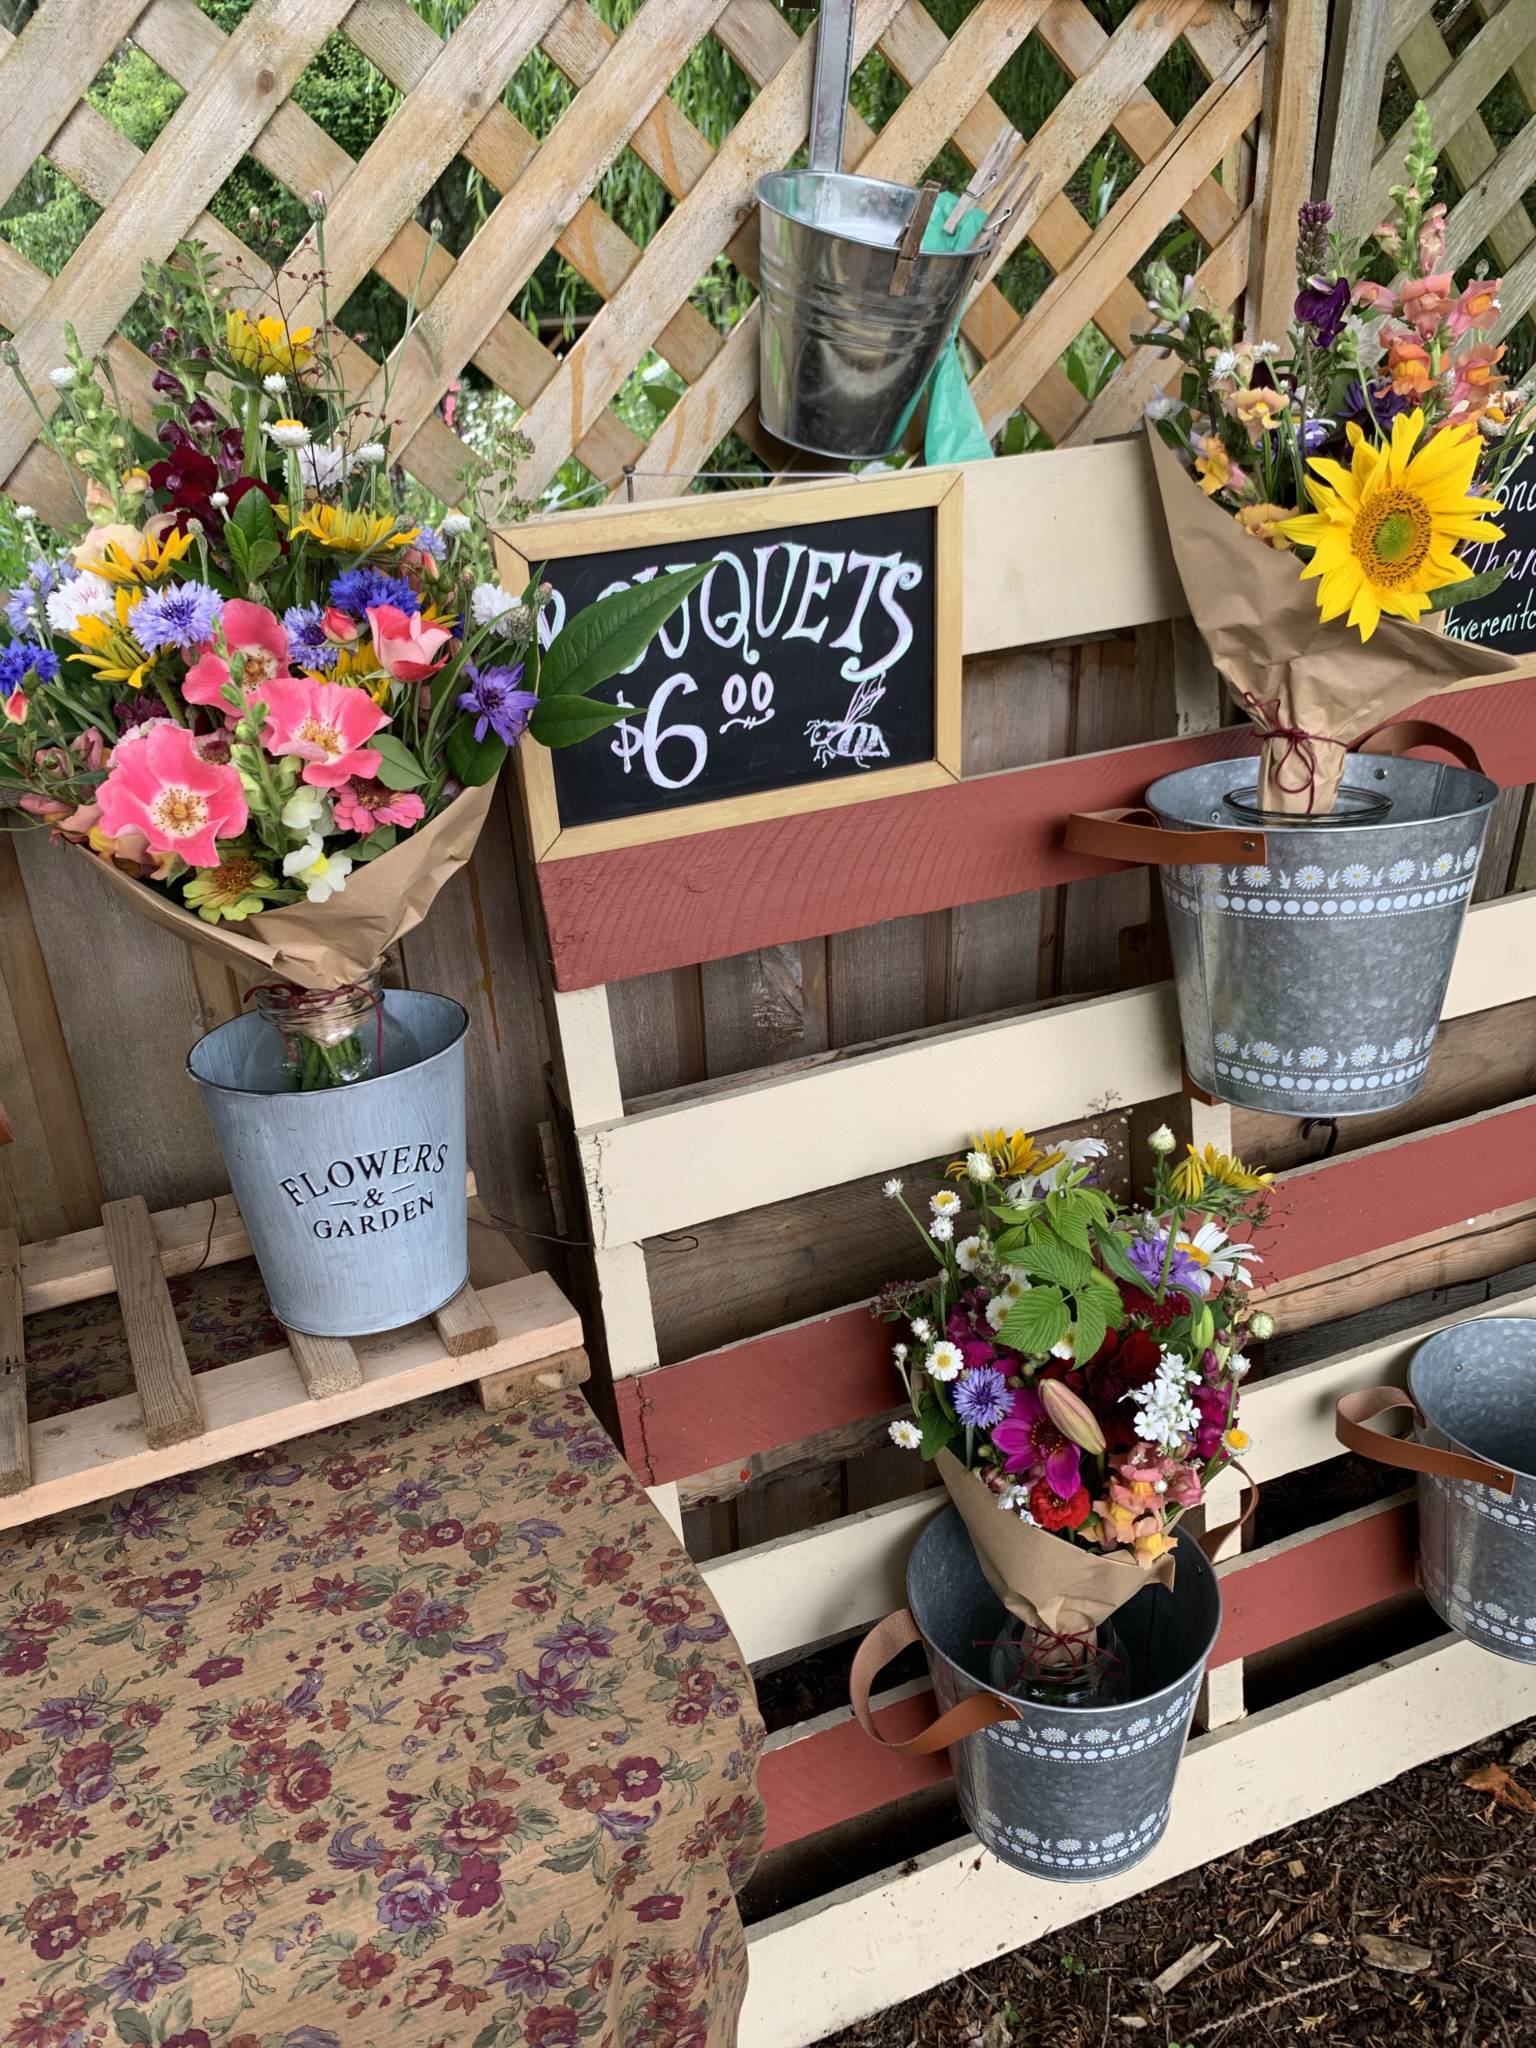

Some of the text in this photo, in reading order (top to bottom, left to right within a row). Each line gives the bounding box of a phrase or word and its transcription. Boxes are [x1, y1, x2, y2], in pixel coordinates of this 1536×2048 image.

[538, 542, 923, 683] UQUETS
[278, 1143, 448, 1207] FLOWERS
[363, 1186, 385, 1209] &
[313, 1191, 435, 1239] GARDEN
